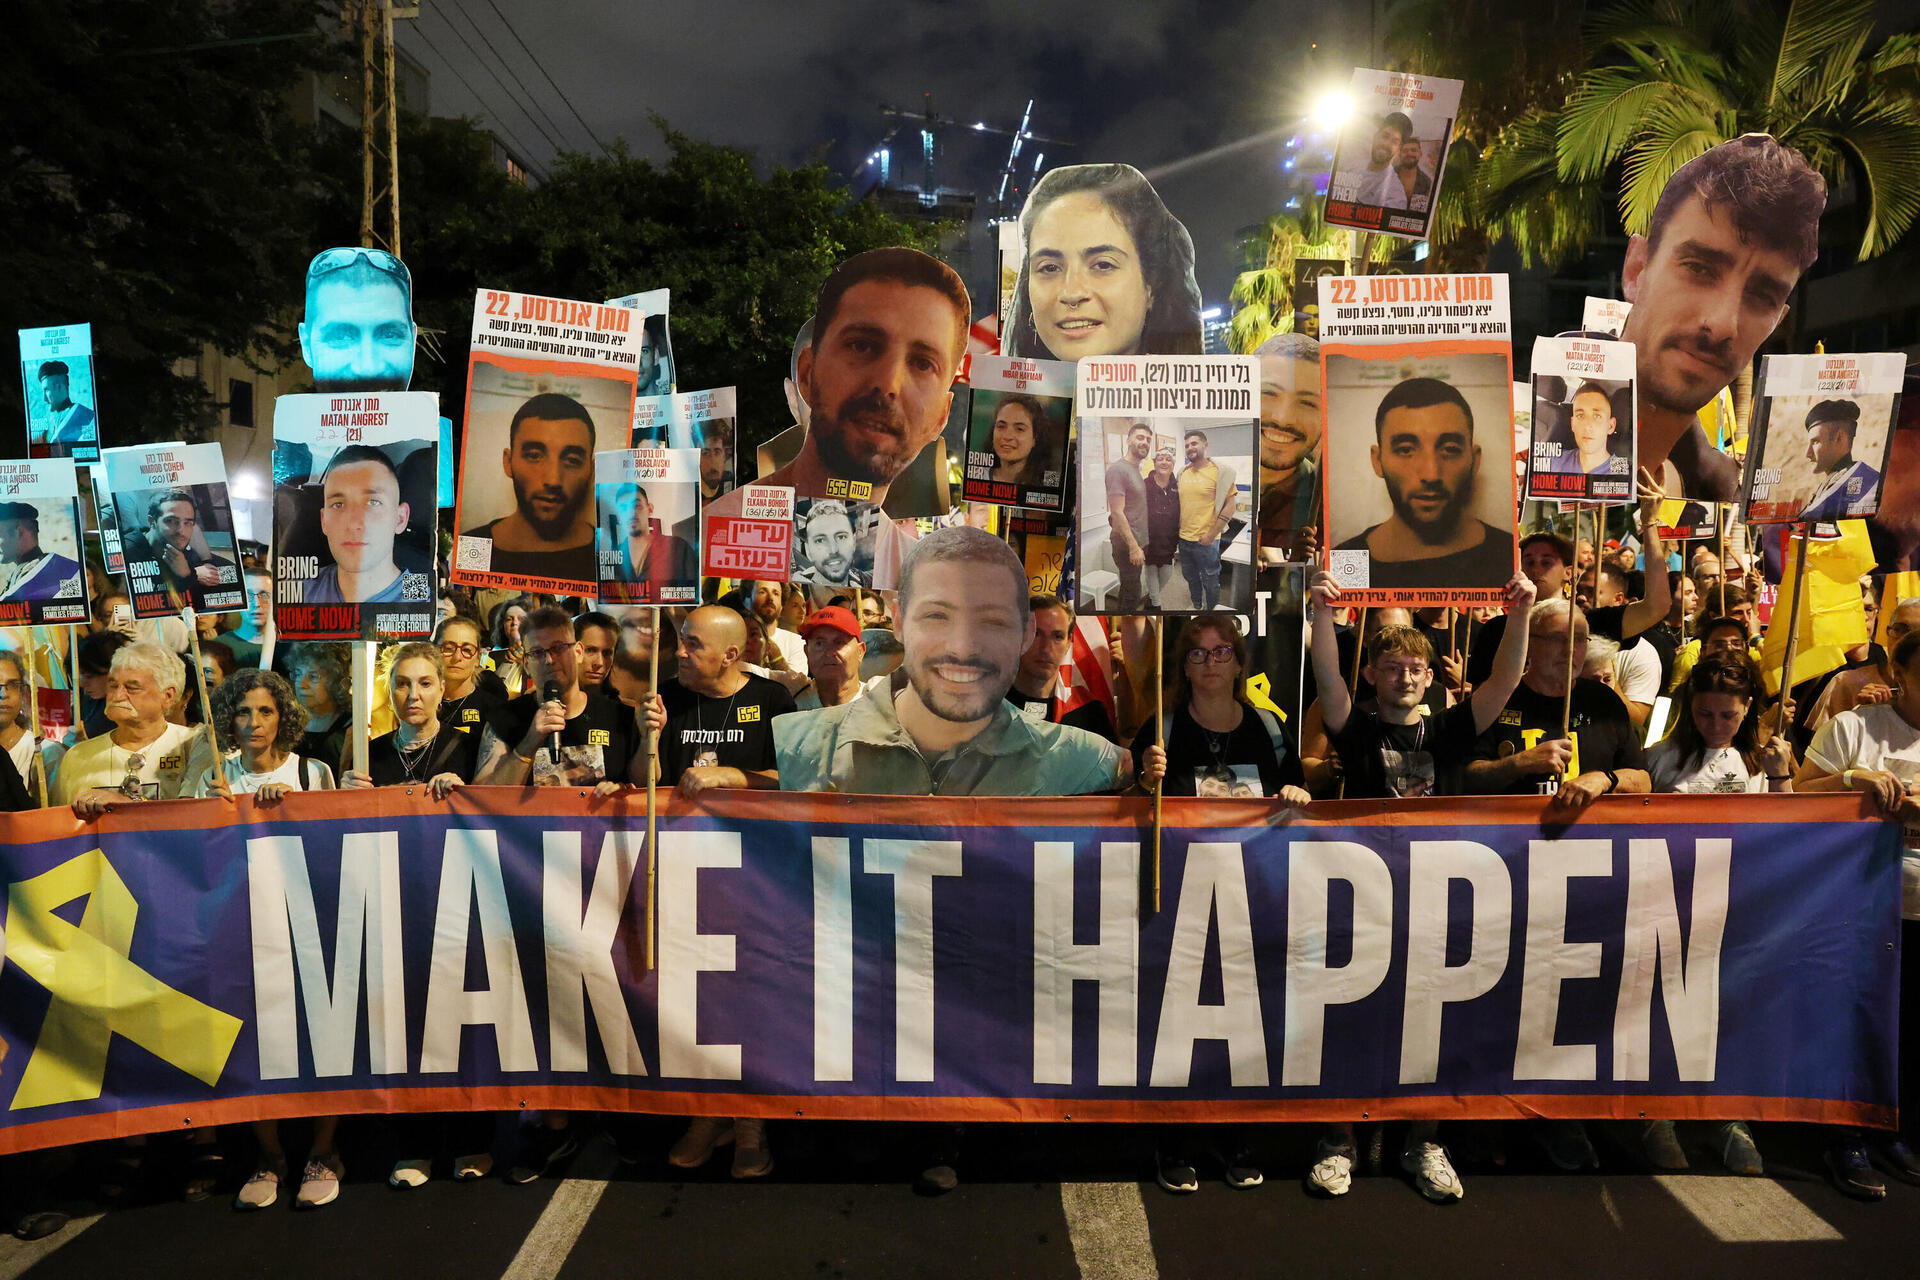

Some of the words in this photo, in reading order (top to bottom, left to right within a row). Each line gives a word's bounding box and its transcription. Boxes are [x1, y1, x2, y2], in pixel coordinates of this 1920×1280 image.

[1328, 202, 1354, 219] HOME
[1355, 206, 1383, 224] NOW!
[1331, 279, 1356, 303] 22
[1363, 278, 1449, 306] אנגרסט,
[1456, 276, 1493, 303] מתן
[485, 292, 510, 316] 22
[1445, 305, 1473, 317] לשמור
[1475, 305, 1492, 317] יצא
[513, 296, 593, 328] אנגרסט,
[596, 306, 631, 332] מתן
[1337, 307, 1359, 320] קשה
[1362, 307, 1385, 318] נפצע
[489, 319, 510, 332] קשה
[511, 322, 532, 334] נפצע
[1382, 323, 1425, 335] מהרשימה
[1427, 323, 1459, 334] המדינה
[1480, 322, 1506, 334] והוצא
[585, 331, 610, 344] לשמור
[611, 335, 627, 346] יצא
[526, 340, 566, 355] מהרשימה
[567, 345, 596, 359] המדינה
[612, 350, 637, 364] והוצא
[1565, 351, 1583, 361] MATAN
[1584, 353, 1605, 363] ANGREST
[1002, 369, 1018, 379] INBAR
[1086, 363, 1137, 383] חטופים.
[1140, 362, 1170, 386] (27),
[1174, 363, 1202, 385] ברמן
[1206, 364, 1227, 383] וזיו
[1231, 363, 1250, 384] גלי
[1818, 370, 1836, 379] MATAN
[1836, 370, 1860, 379] ANGREST
[1085, 386, 1142, 409] המוחלט
[1147, 388, 1201, 412] הניצחון
[1205, 388, 1250, 410] תמונת
[331, 399, 361, 412] אנגרסט
[364, 398, 380, 412] מתן
[321, 413, 349, 427] MATAN
[351, 412, 389, 426] ANGREST
[346, 428, 362, 442] (21)
[1534, 441, 1562, 457] BRING
[635, 459, 670, 469] BRASLAVSKI
[968, 451, 995, 467] BRING
[1533, 458, 1551, 472] HIM
[19, 465, 31, 474] מתן
[140, 464, 163, 475] NIMROD
[164, 461, 185, 472] COHEN
[967, 466, 984, 480] HER
[10, 473, 39, 484] ANGREST
[1532, 474, 1559, 490] HOME
[1560, 475, 1586, 491] NOW!
[1754, 469, 1782, 485] BRING
[750, 489, 770, 498] בוחבוט
[771, 489, 787, 499] אלקנה
[827, 478, 848, 496] 652
[851, 483, 869, 497] בעזה
[966, 480, 990, 496] HOME
[991, 483, 1017, 500] NOW!
[1751, 485, 1769, 501] HIM
[747, 498, 767, 507] ELKANA
[768, 499, 789, 508] BOHBOT
[745, 508, 761, 518] (36)
[104, 529, 119, 541] BRI
[733, 523, 785, 543] עדיין
[600, 550, 623, 565] BRING
[717, 549, 784, 570] בעזה.
[129, 560, 161, 578] BRING
[277, 556, 319, 580] BRING
[600, 565, 615, 580] HIM
[132, 576, 154, 594] HIM
[486, 574, 504, 585] צריך
[510, 576, 527, 587] אותי
[277, 580, 303, 604] HIM
[660, 591, 680, 599] FAMILIES
[681, 591, 695, 599] FORUM
[1367, 590, 1386, 602] צריך
[1393, 590, 1415, 602] אותי
[0, 600, 31, 619] NOW!
[135, 593, 166, 612] HOME
[277, 606, 316, 631] HOME
[319, 603, 361, 630] NOW!
[376, 613, 399, 621] HOSTAGES
[376, 621, 405, 632] FAMILIES
[406, 621, 430, 632] FORUM
[463, 709, 480, 722] 652
[739, 707, 759, 721] 652
[590, 730, 609, 744] 652
[680, 729, 724, 745] ברסלבסקי
[727, 729, 744, 743] רום
[159, 756, 181, 769] 652
[246, 828, 743, 1082] MAKE
[811, 835, 965, 1083] IT
[1032, 837, 1733, 1087] HAPPEN
